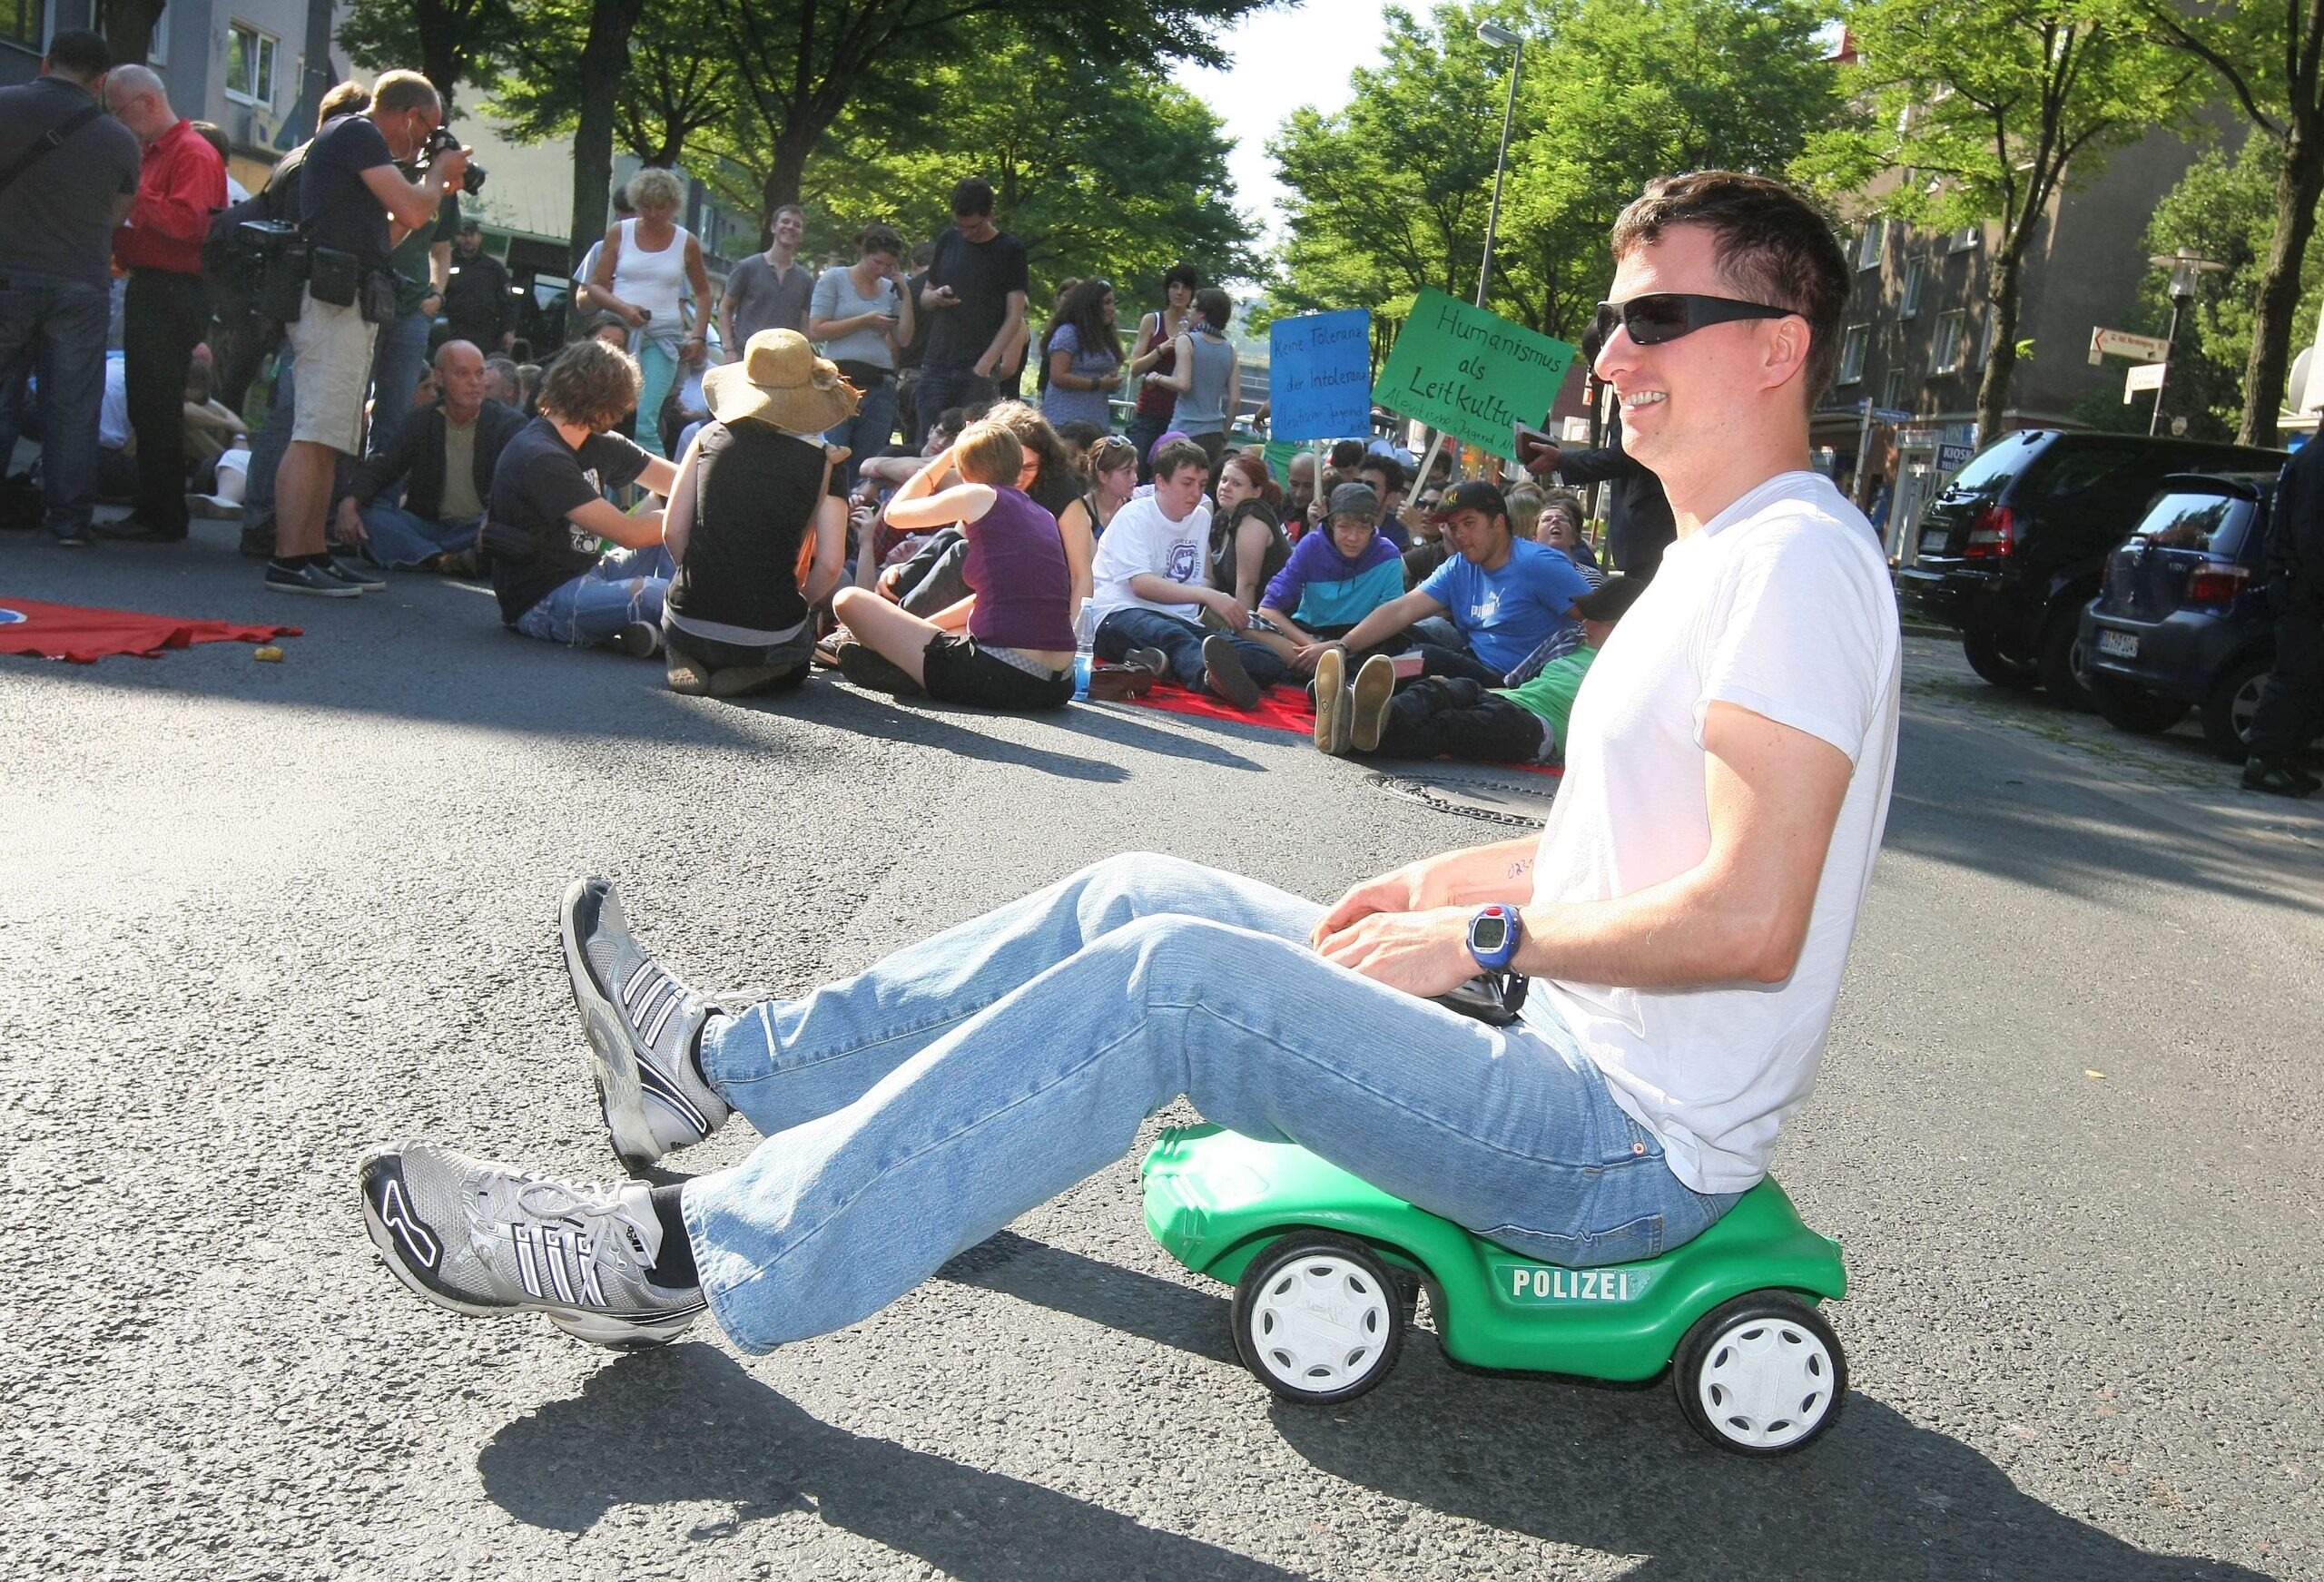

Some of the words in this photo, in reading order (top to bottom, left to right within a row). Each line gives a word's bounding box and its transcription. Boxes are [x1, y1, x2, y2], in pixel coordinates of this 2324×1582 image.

[1275, 339, 1305, 358] Keine
[1310, 327, 1362, 347] Toleranz
[1437, 305, 1562, 372] Humanismus
[1286, 372, 1304, 392] der
[1310, 365, 1366, 388] Intoleranz
[1459, 356, 1486, 380] als
[1453, 418, 1494, 446] Jugend
[1512, 1269, 1628, 1301] POLIZEI
